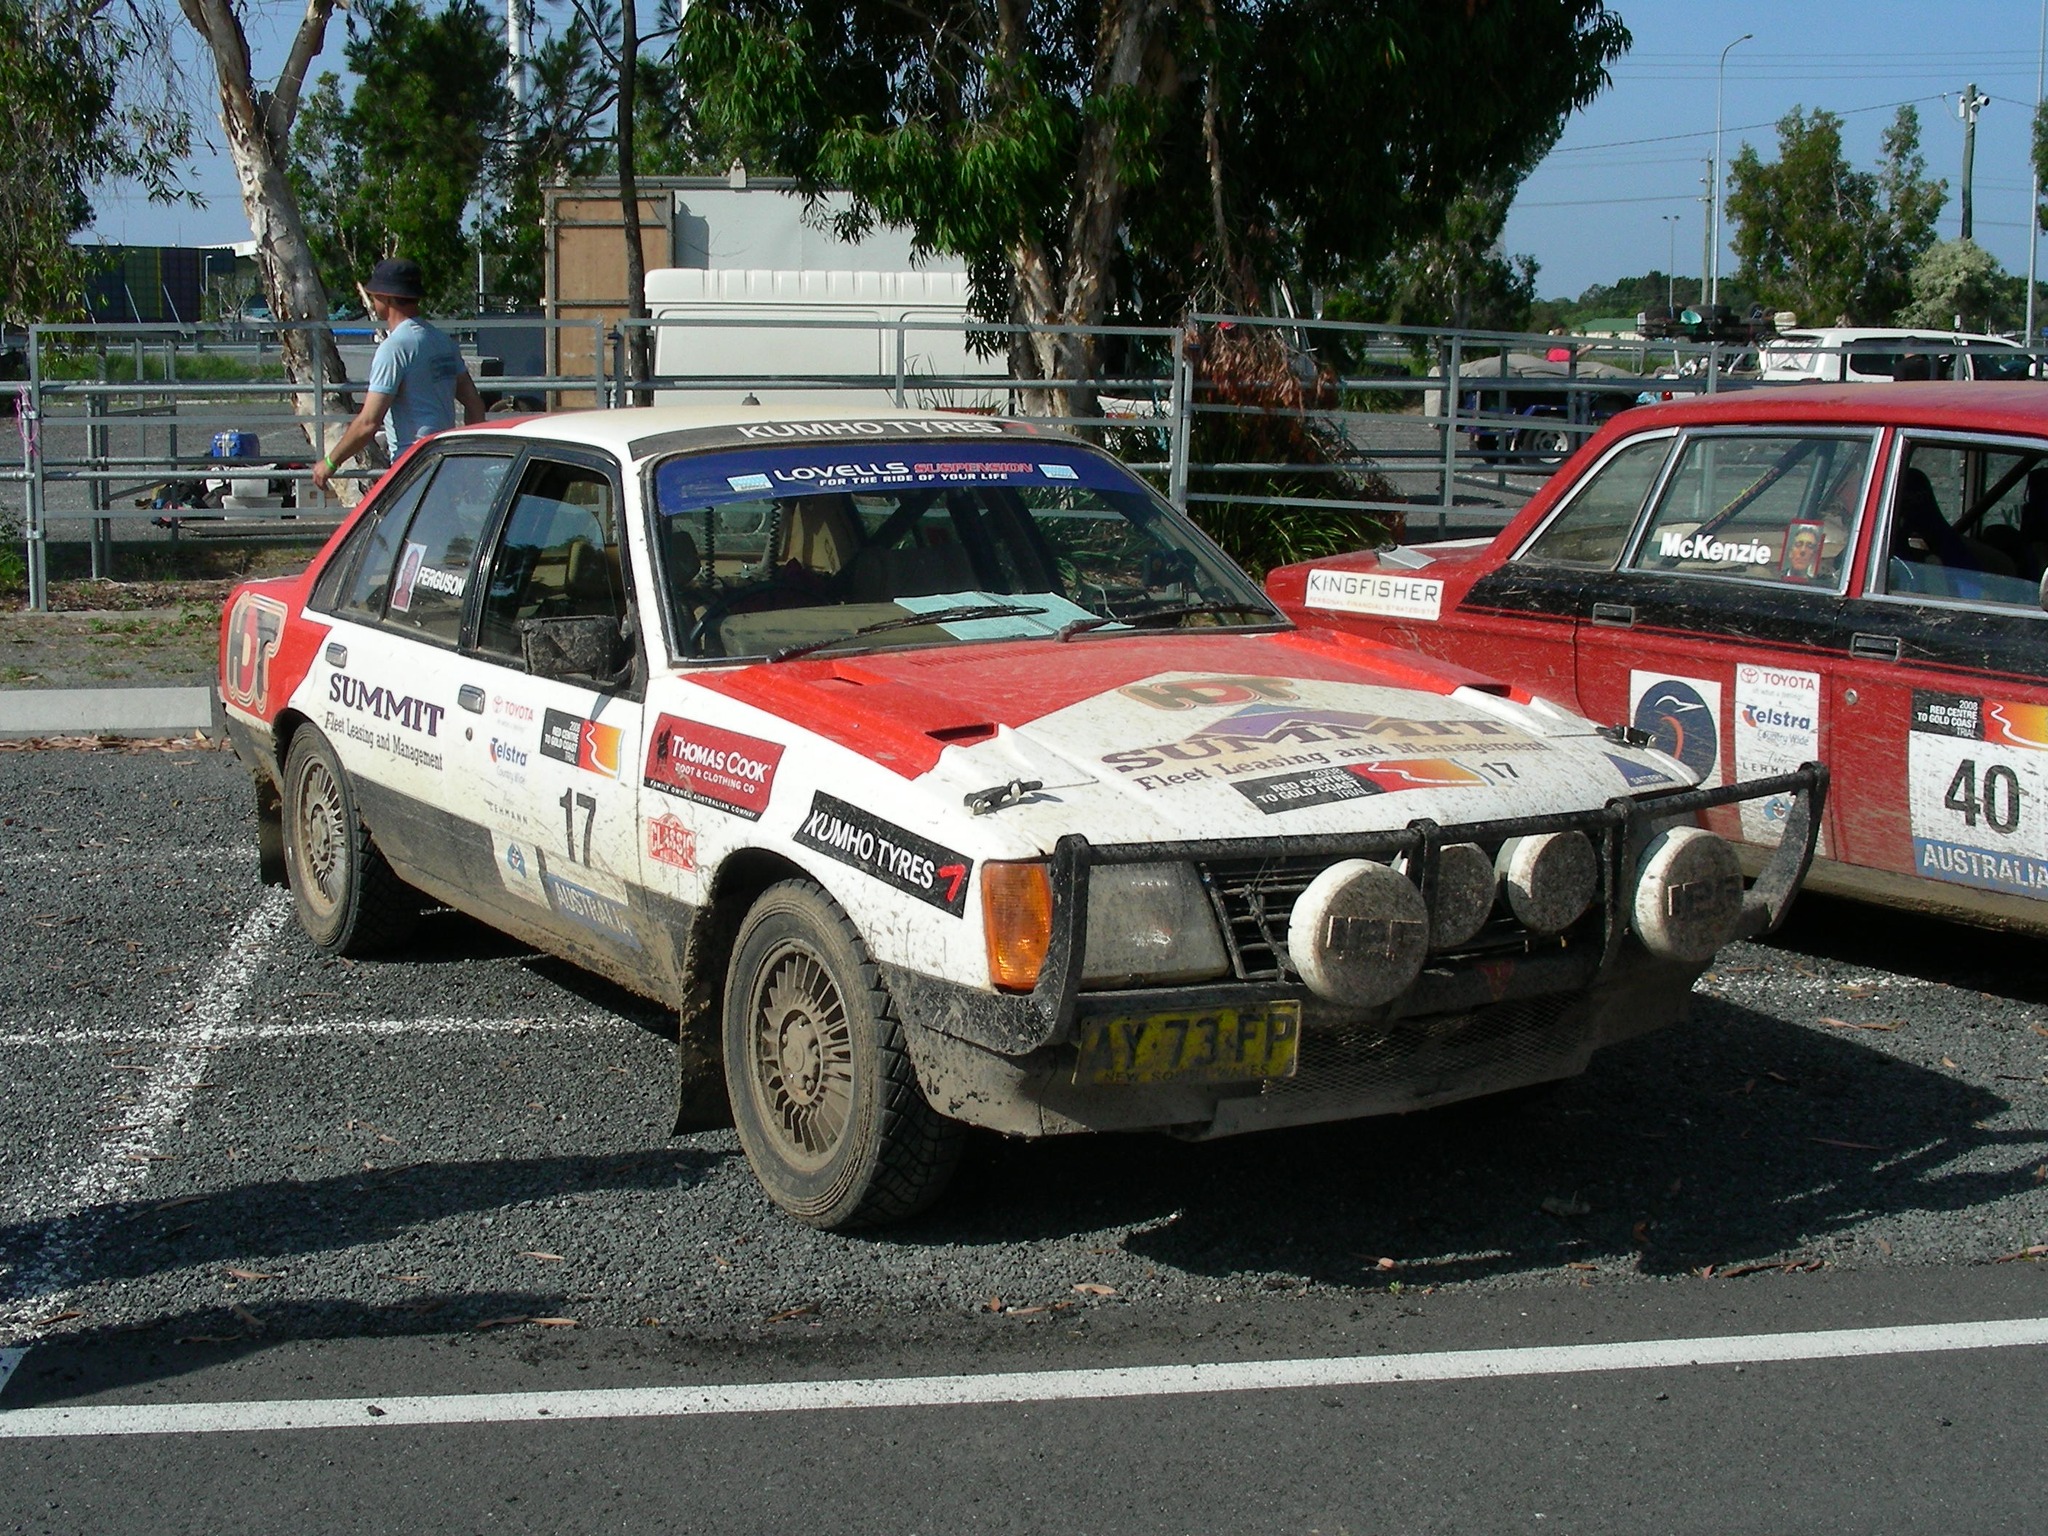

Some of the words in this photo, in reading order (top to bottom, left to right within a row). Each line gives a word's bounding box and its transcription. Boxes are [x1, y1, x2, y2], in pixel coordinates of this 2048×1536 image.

[737, 421, 884, 439] KUMHO
[885, 421, 1003, 435] TYRES
[773, 462, 909, 482] LOVELLS
[913, 462, 1033, 474] SUSPENSION
[819, 477, 848, 486] FOR
[851, 476, 878, 485] THE
[883, 474, 913, 483] RIDE
[918, 474, 935, 482] OF
[941, 473, 977, 481] YOUR
[1659, 532, 1771, 565] McKenzie
[417, 566, 466, 597] FERGUSON
[1310, 574, 1438, 603] KINGFISHER
[1763, 672, 1815, 691] TOYOTA
[329, 672, 444, 737] SUMMIT
[506, 701, 534, 721] TOYOTA
[1929, 704, 1946, 716] RED
[1947, 707, 1978, 720] CENTRE
[1959, 700, 1978, 711] 2008
[1745, 704, 1811, 731] Telstra
[1917, 711, 1928, 722] TO
[1928, 713, 1949, 726] GOLD
[1950, 717, 1977, 729] COAST
[324, 711, 345, 733] Fleet
[346, 718, 374, 749] Leasing
[376, 733, 391, 751] and
[393, 735, 443, 770] Management
[544, 733, 551, 744] TO
[551, 736, 562, 748] GOLD
[562, 740, 578, 753] COAST
[552, 726, 562, 737] RED
[1956, 726, 1976, 738] TRIAL
[492, 737, 528, 766] Telstra
[1101, 718, 1506, 773] SUMMIT
[672, 735, 726, 771] THOMAS
[726, 752, 768, 783] COOK
[1133, 767, 1212, 791] Fleet
[1213, 752, 1331, 776] Leasing
[1339, 745, 1388, 758] and
[1389, 741, 1552, 755] Management
[1480, 761, 1520, 779] 17
[1743, 762, 1798, 776] LEHMA
[674, 762, 695, 777] BOOT
[696, 769, 702, 777] &
[702, 772, 741, 790] CLOTHING
[743, 782, 755, 794] CO
[1270, 781, 1300, 793] RED
[1300, 773, 1354, 788] CENTRE
[1311, 767, 1344, 778] 2008
[650, 779, 669, 792] FAMILY
[693, 793, 730, 810] AUSTRALIAN
[731, 805, 756, 819] COMPANY
[1257, 793, 1279, 804] TO
[1279, 787, 1317, 800] GOLD
[1316, 780, 1362, 793] COAST
[1333, 787, 1372, 799] TRIAL
[1944, 759, 2020, 834] 40
[560, 787, 596, 868] 17
[651, 822, 695, 869] CLASSIC
[803, 809, 874, 860] KUMHO
[874, 837, 937, 889] TYRES
[1923, 843, 2048, 889] AUSTRALIA
